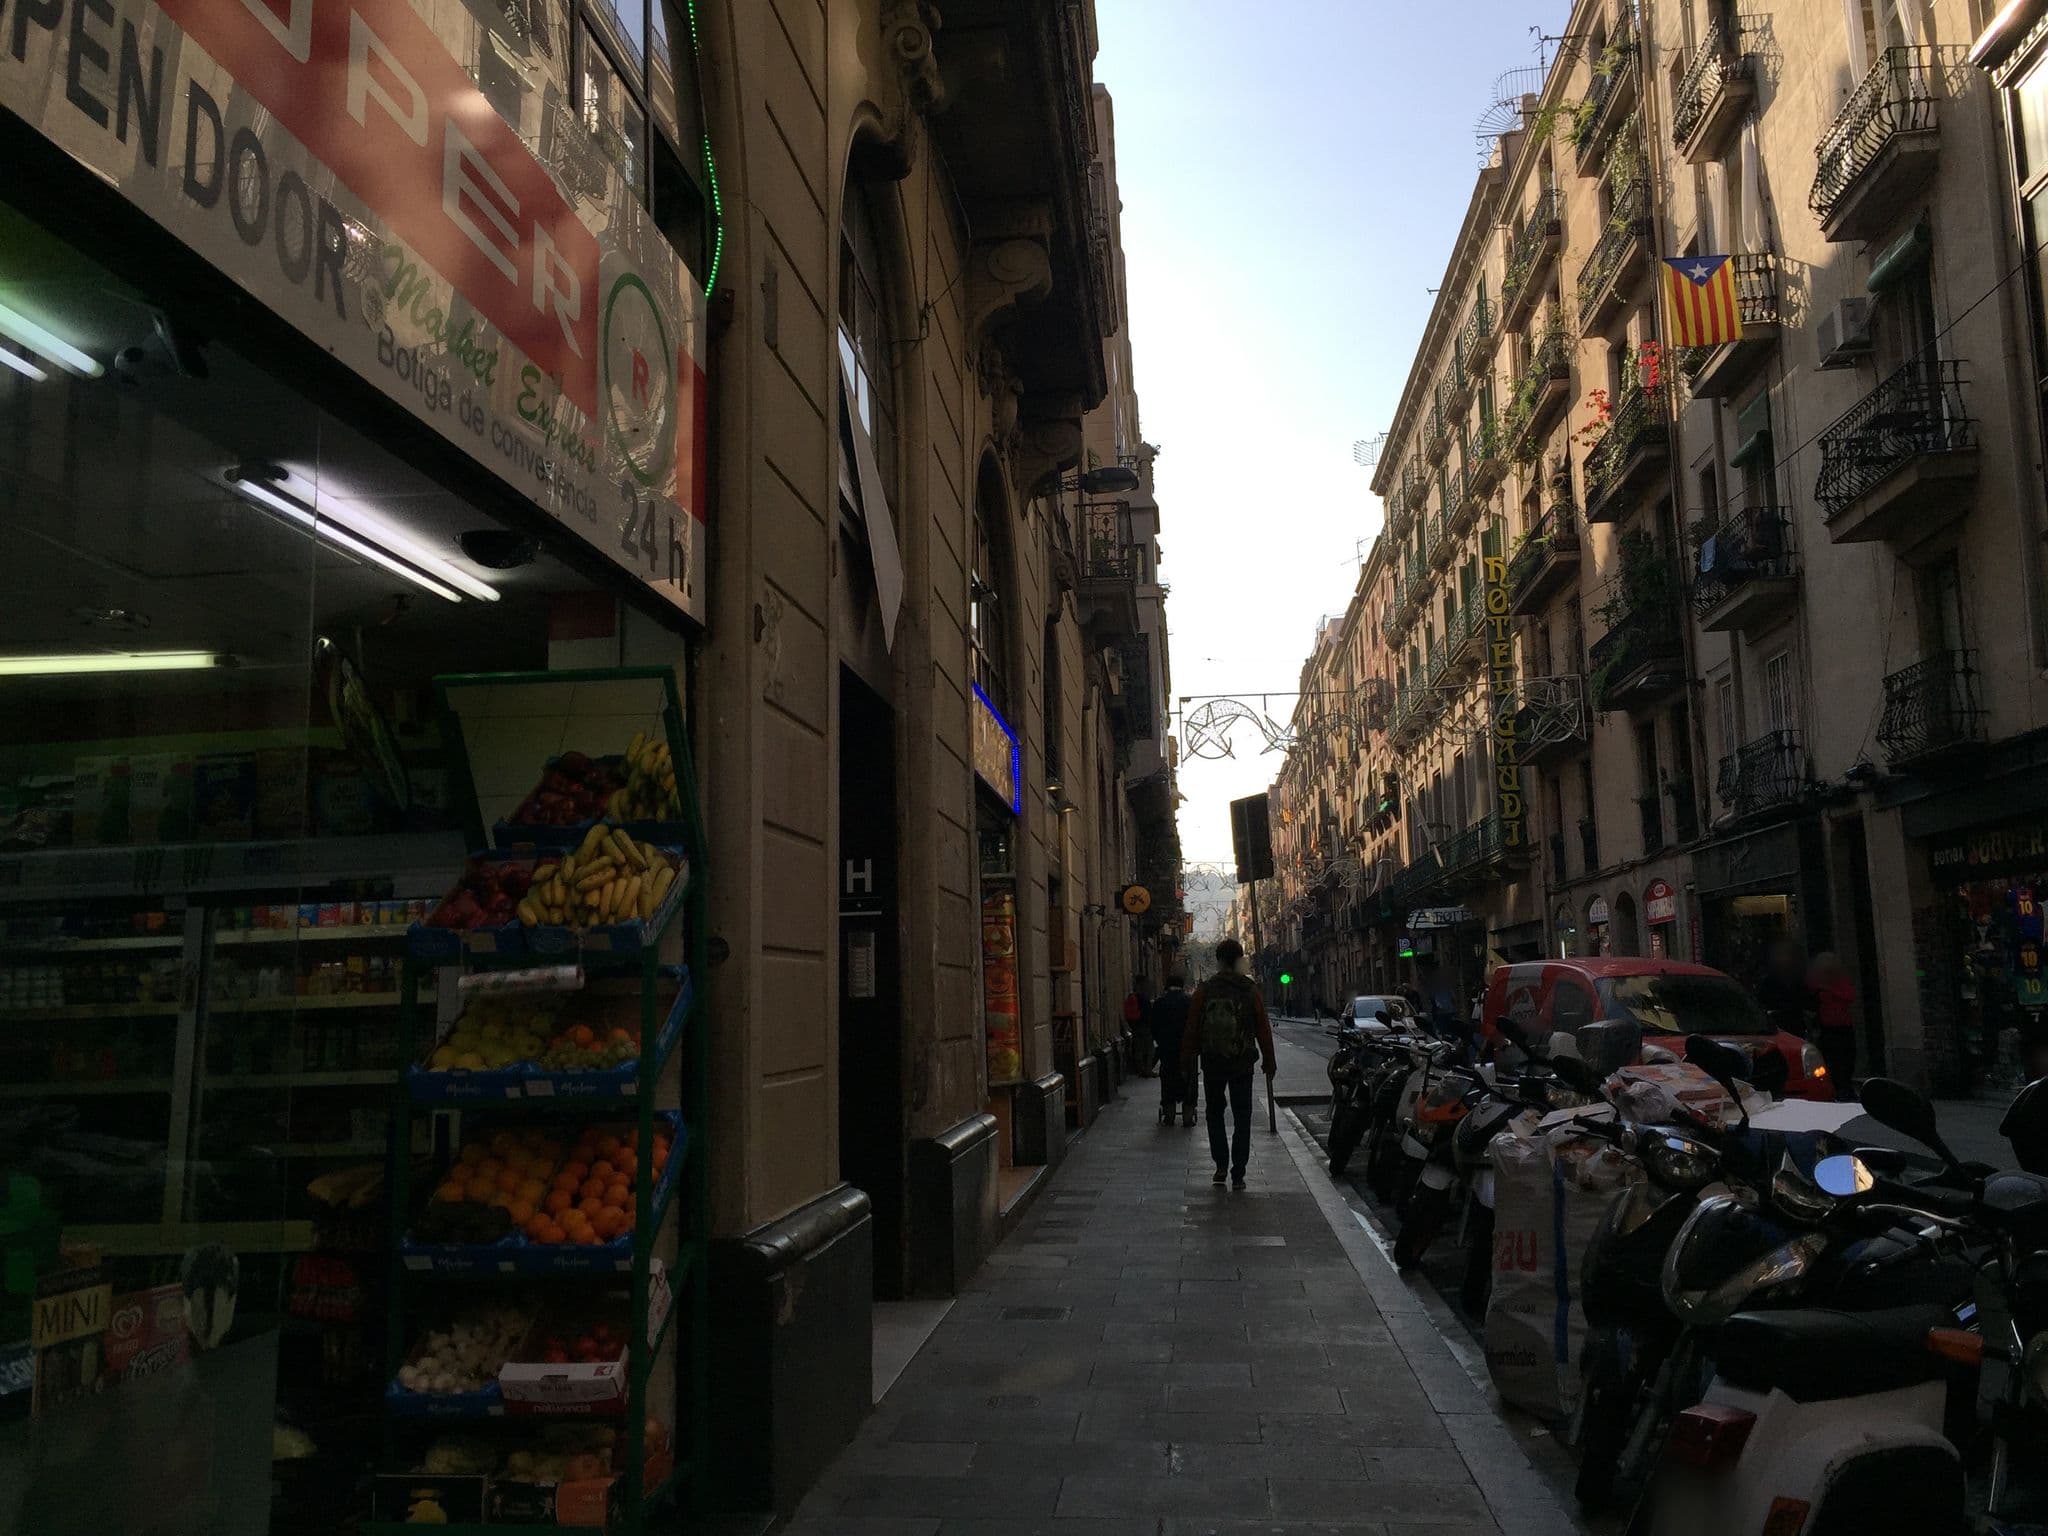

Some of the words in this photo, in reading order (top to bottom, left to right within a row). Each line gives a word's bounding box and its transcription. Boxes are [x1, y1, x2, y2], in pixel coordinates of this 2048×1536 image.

[0, 0, 163, 168] PEN
[183, 77, 346, 321] DOOR
[377, 327, 451, 412] Botiga
[459, 392, 485, 437] de
[383, 244, 498, 386] Market
[516, 364, 597, 474] Express
[632, 349, 650, 402] R
[620, 480, 659, 572] 24
[1484, 556, 1515, 695] HOTEL
[1494, 711, 1522, 847] GAUDI
[846, 858, 873, 894] H
[2018, 900, 2033, 915] 10
[2024, 981, 2041, 994] 10
[39, 1293, 99, 1338] MINI
